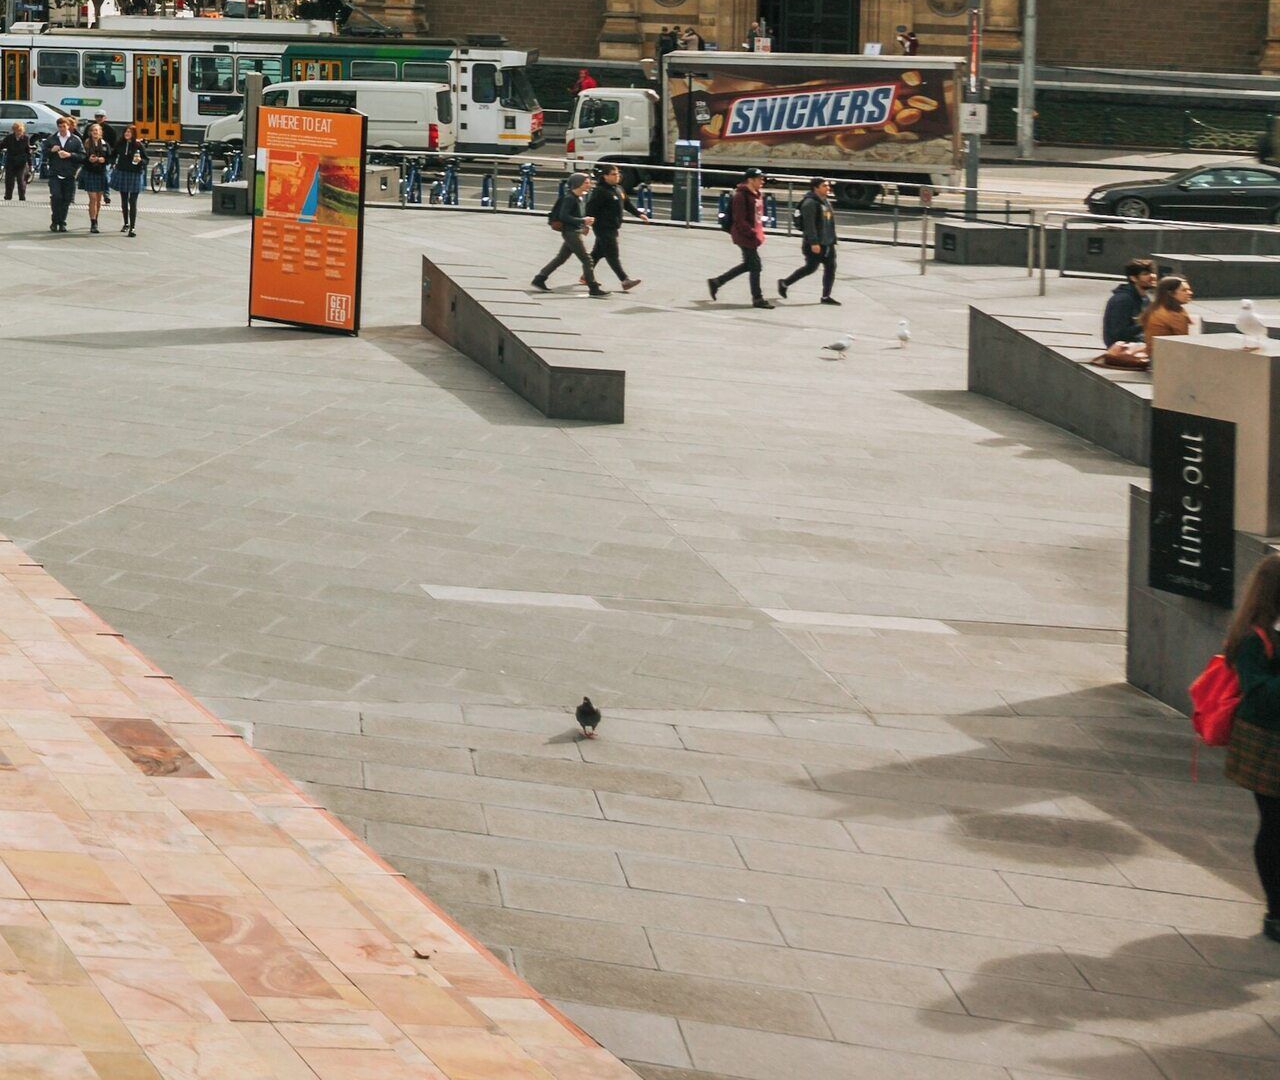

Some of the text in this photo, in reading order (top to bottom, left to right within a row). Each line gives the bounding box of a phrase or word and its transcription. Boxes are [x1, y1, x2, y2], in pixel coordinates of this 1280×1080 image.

[267, 113, 333, 134] WHERE TO EAT
[730, 87, 895, 135] SNICKERS
[330, 295, 347, 309] GET
[330, 308, 346, 322] FED
[1180, 433, 1204, 485] out
[1172, 495, 1203, 568] time
